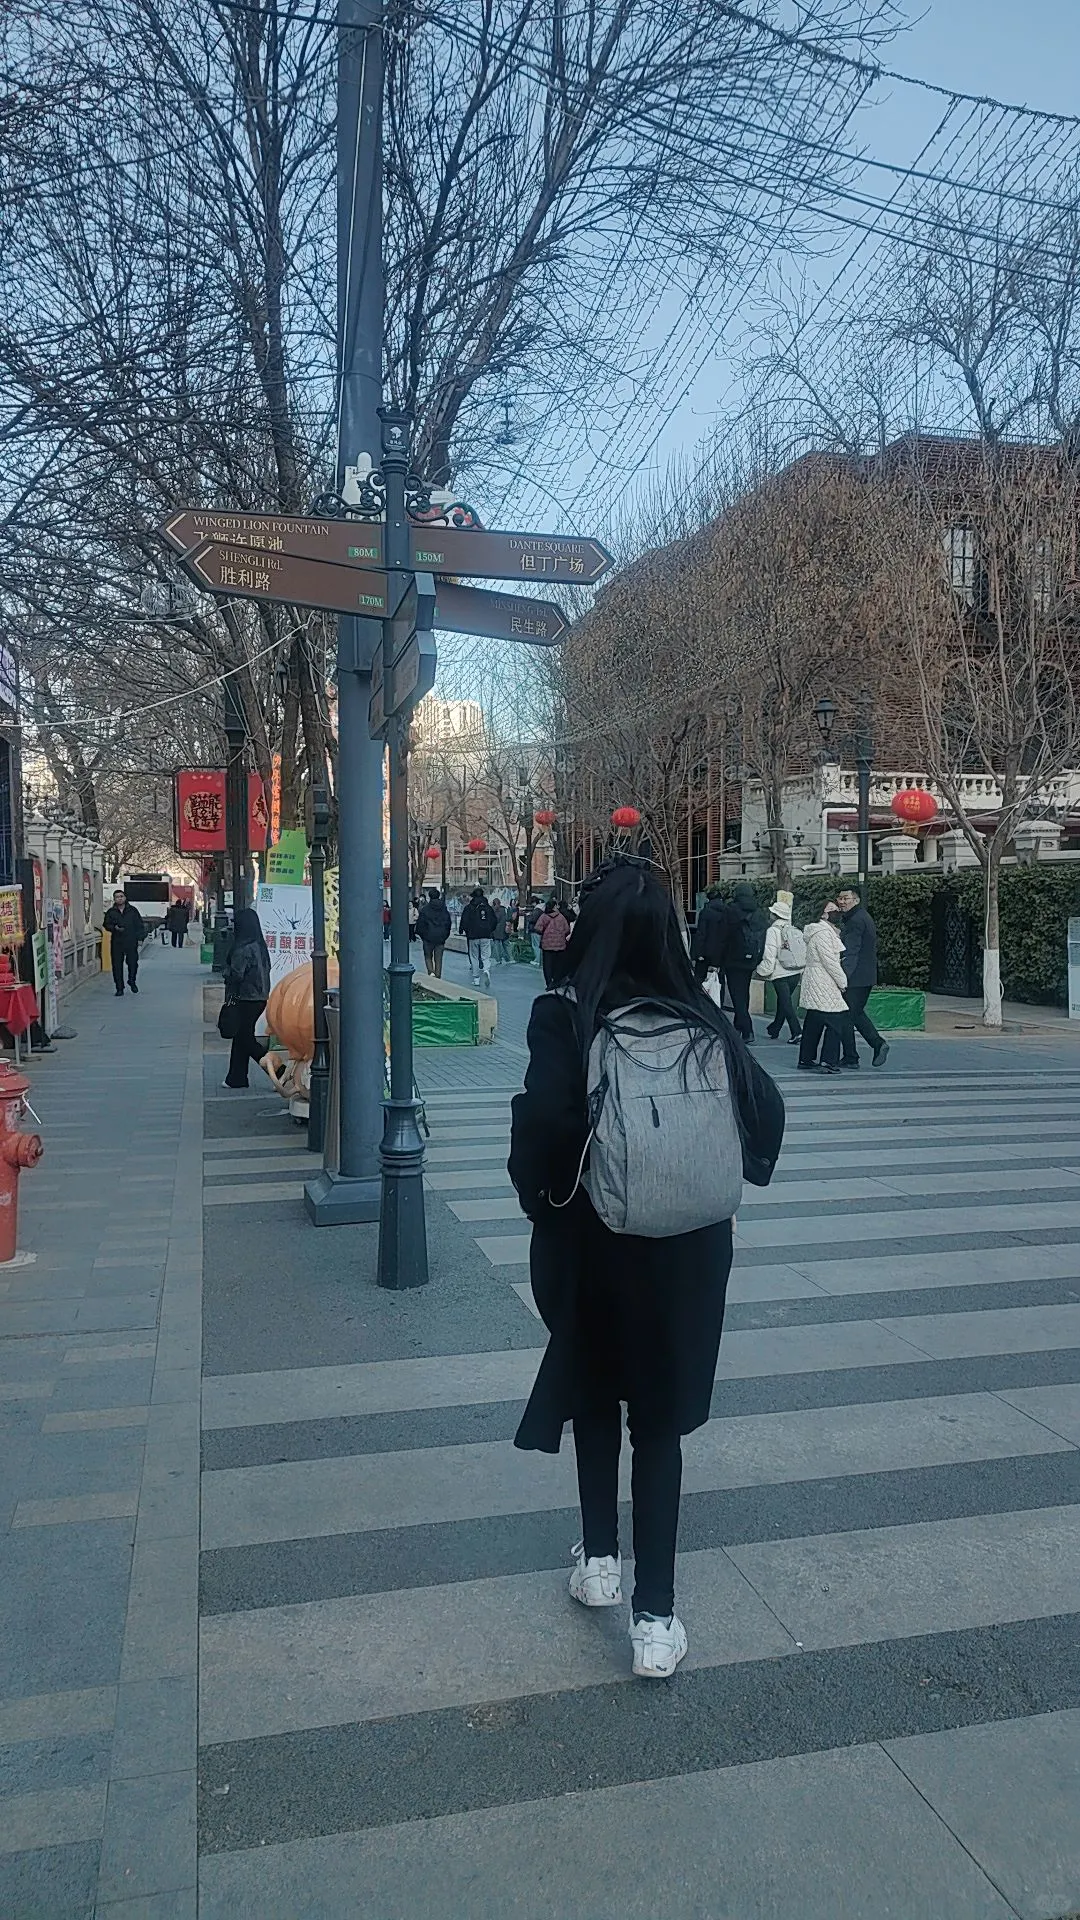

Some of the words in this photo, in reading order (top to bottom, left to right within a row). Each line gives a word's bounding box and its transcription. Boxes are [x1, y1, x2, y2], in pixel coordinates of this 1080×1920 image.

[193, 516, 241, 529] WINGED
[243, 520, 271, 531] LION
[273, 522, 329, 536] FOUNTAIN
[219, 550, 266, 569] SHENGLI
[353, 548, 373, 557] 80M
[417, 552, 442, 562] 150M
[520, 553, 585, 574] 但丁广场
[219, 565, 271, 592] 胜利路
[361, 595, 383, 606] 170M
[510, 616, 548, 637] 民生路
